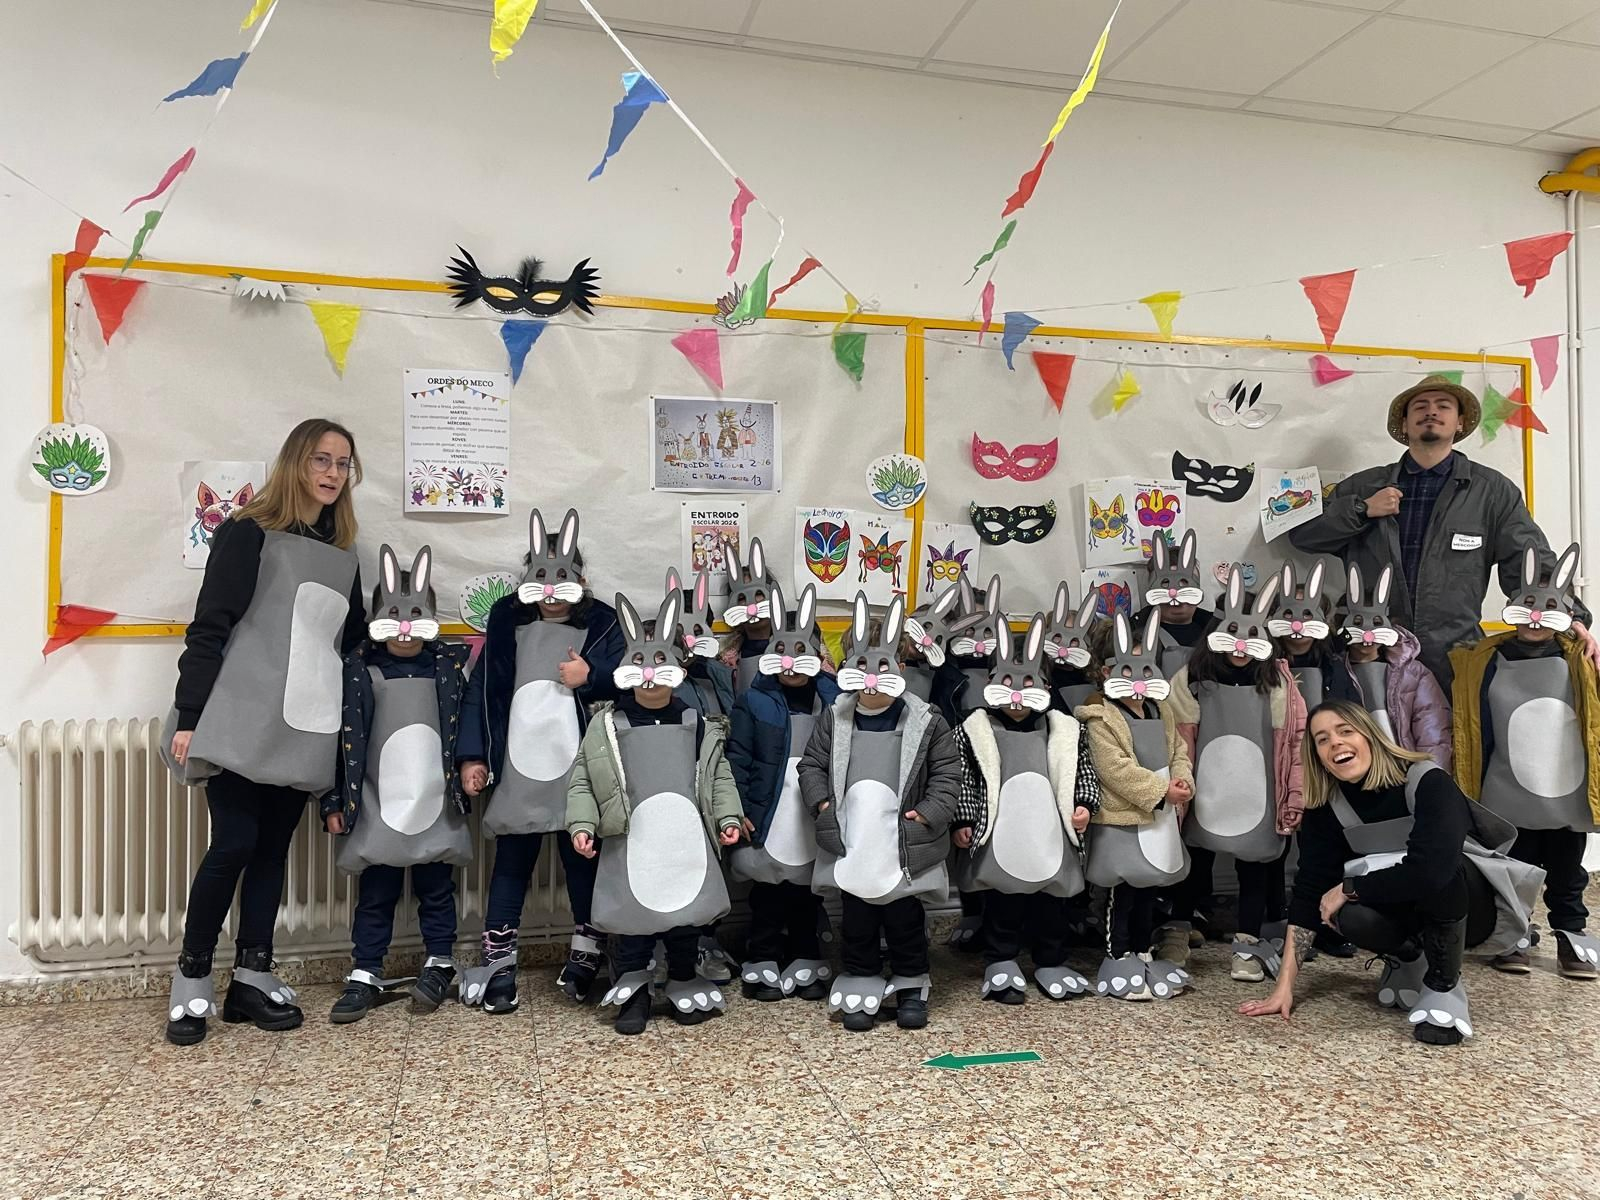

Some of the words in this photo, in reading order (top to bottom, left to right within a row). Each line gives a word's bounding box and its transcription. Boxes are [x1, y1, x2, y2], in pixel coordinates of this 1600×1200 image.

[427, 377, 455, 385] ORDES
[470, 380, 494, 388] MECO
[691, 511, 739, 519] ENTROIDO
